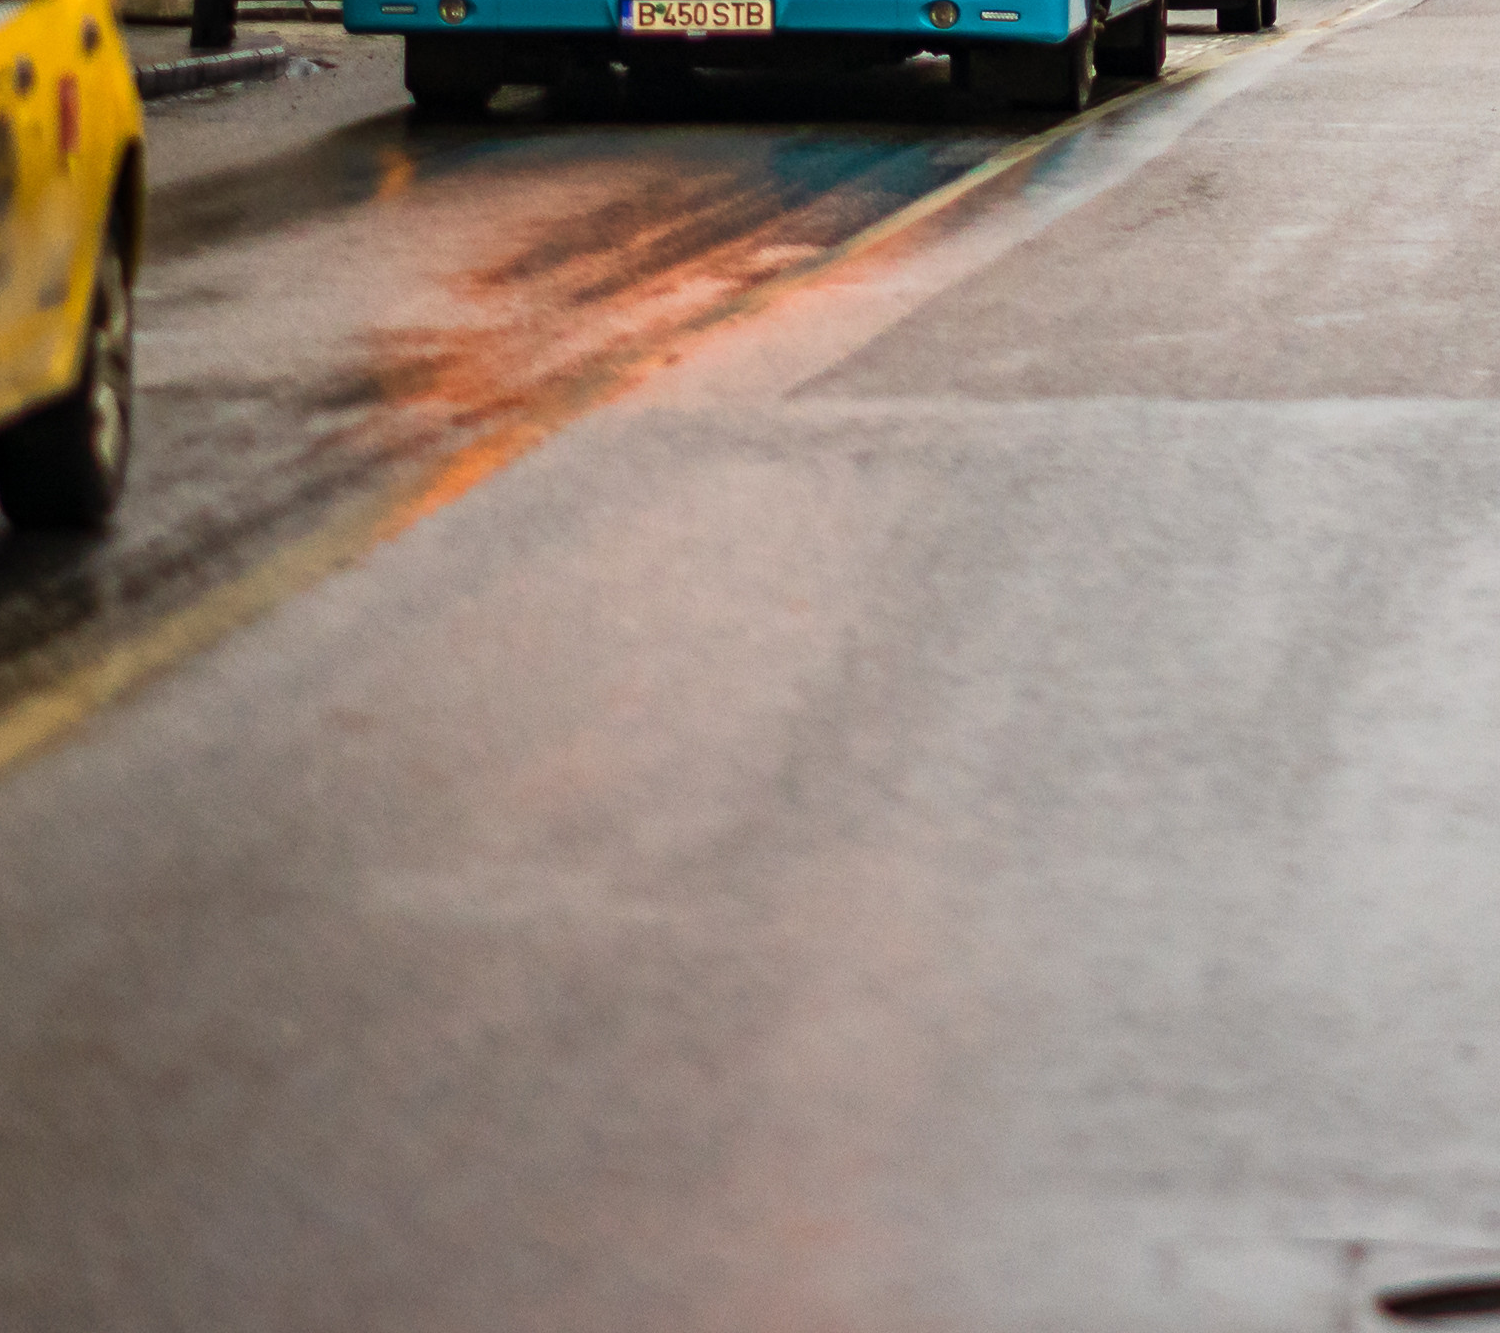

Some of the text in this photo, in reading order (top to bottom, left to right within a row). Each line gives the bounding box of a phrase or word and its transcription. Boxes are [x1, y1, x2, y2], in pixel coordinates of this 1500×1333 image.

[638, 2, 764, 26] B 450 STB
